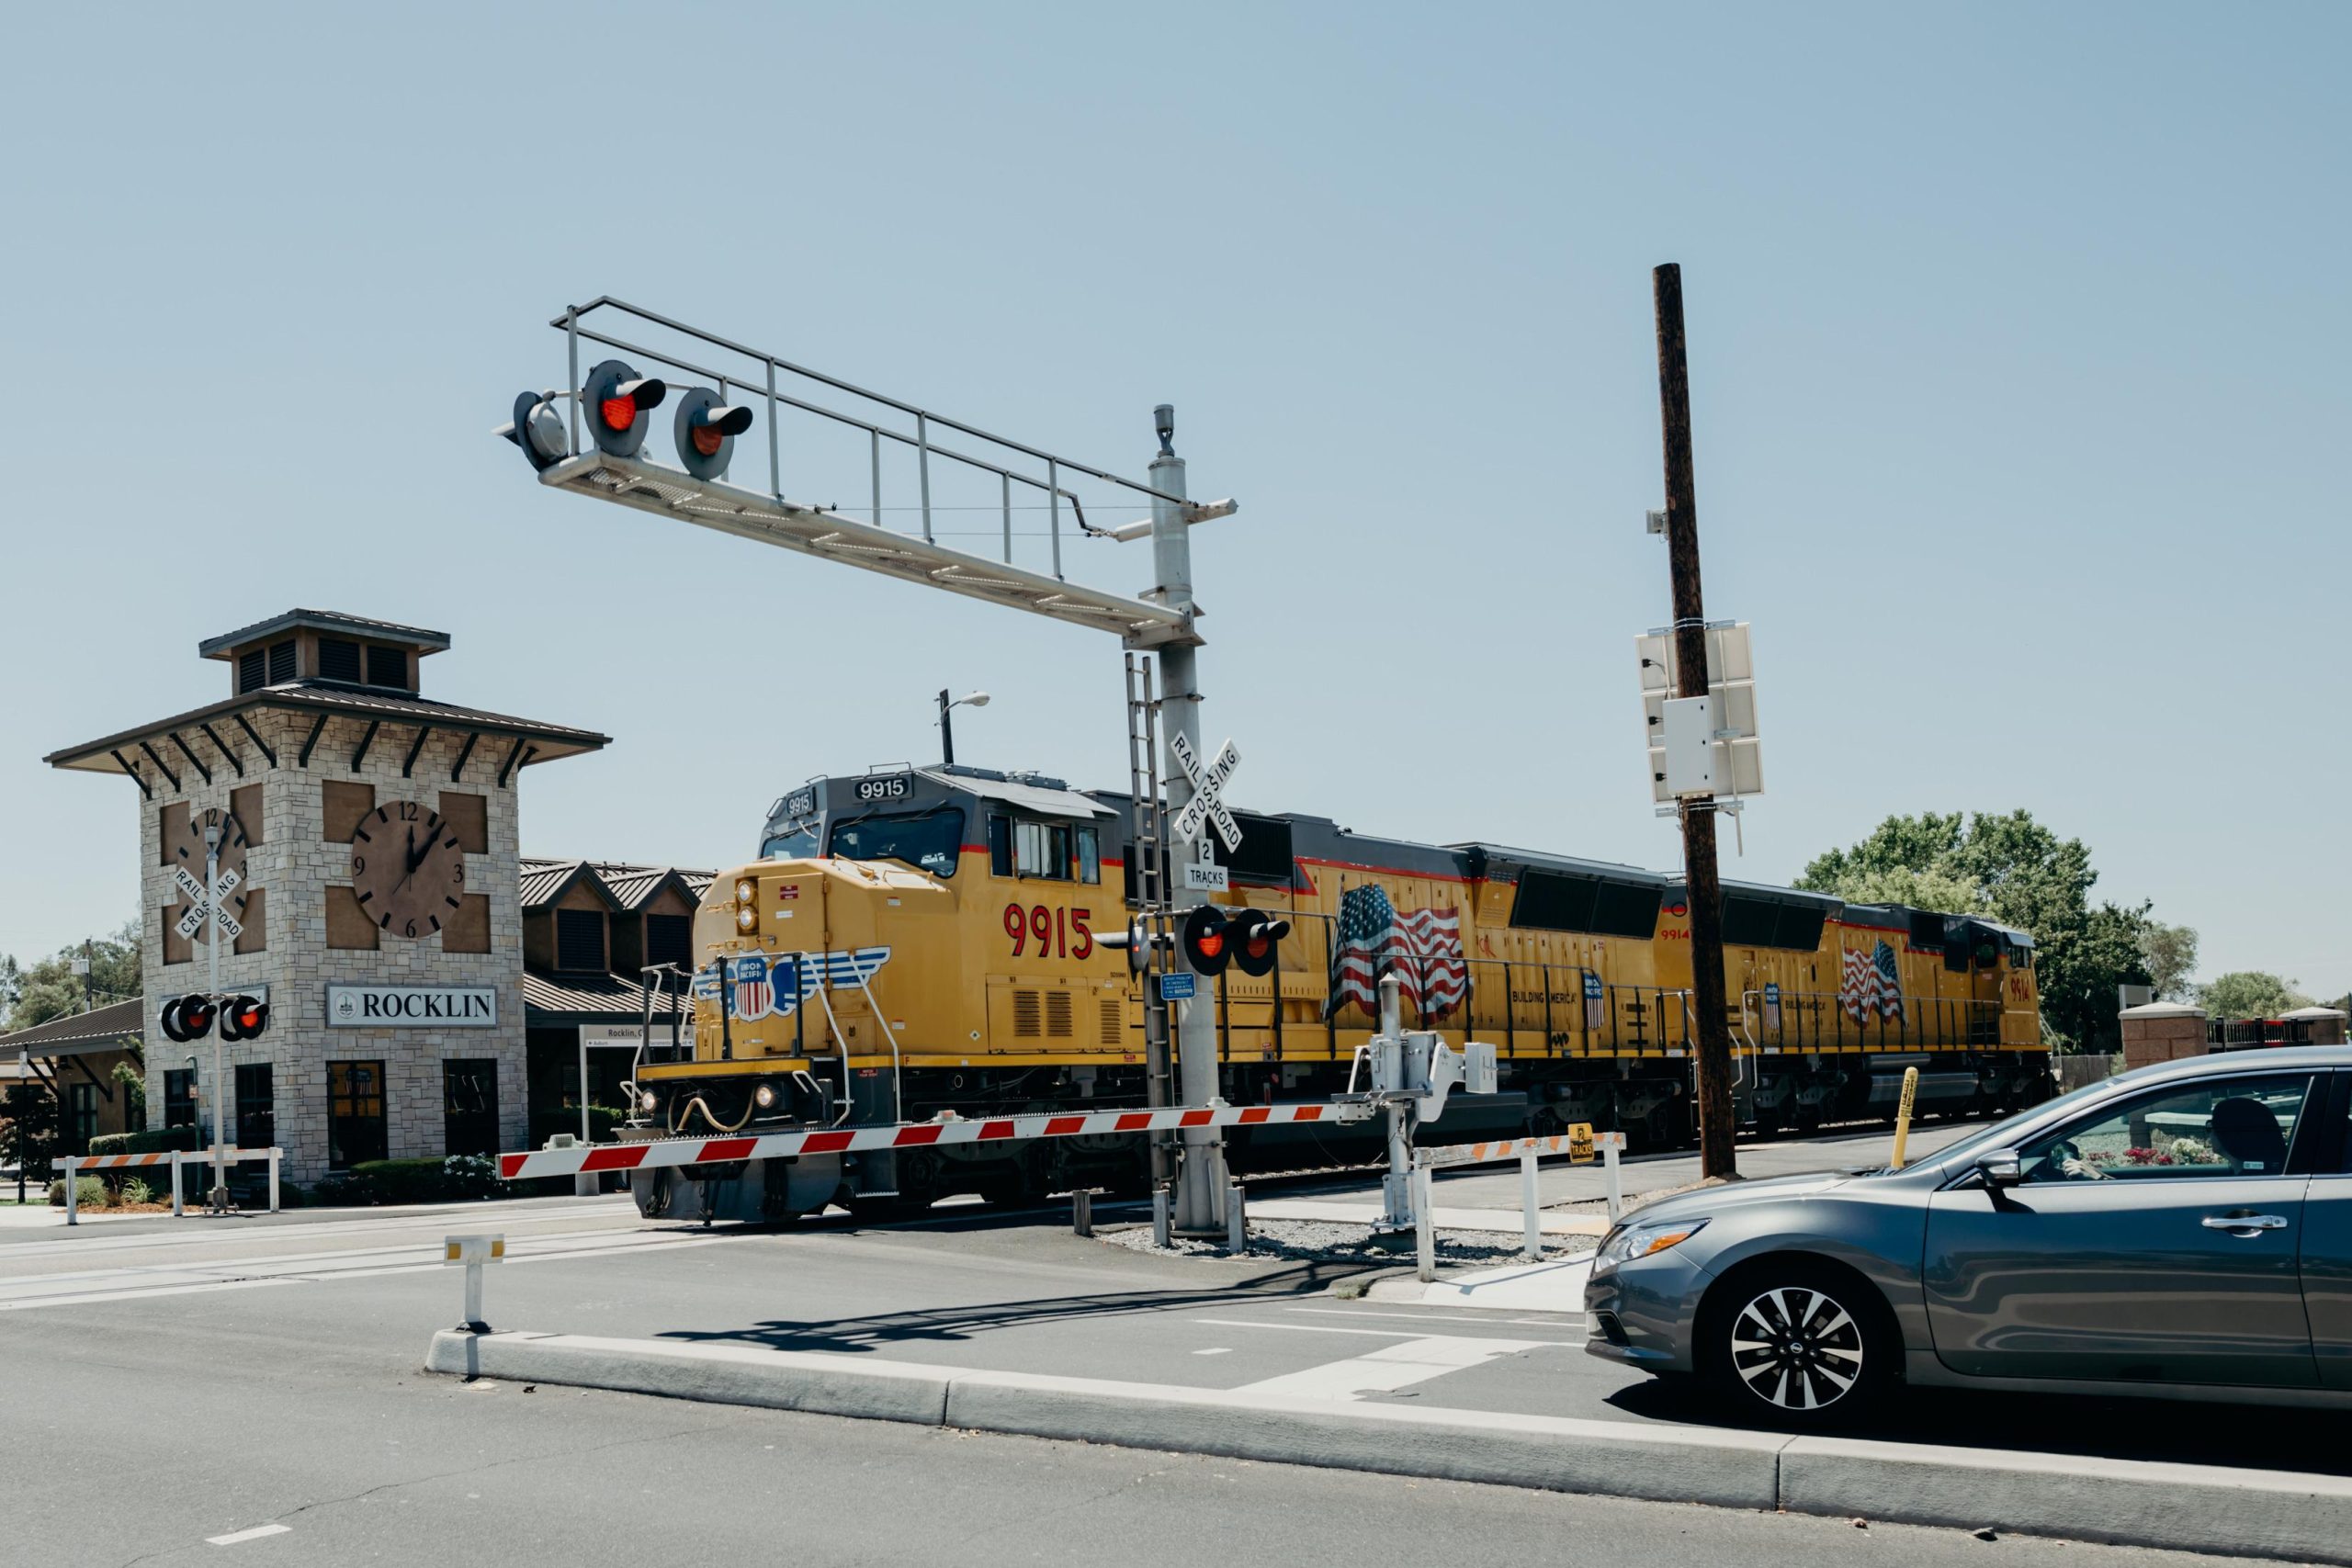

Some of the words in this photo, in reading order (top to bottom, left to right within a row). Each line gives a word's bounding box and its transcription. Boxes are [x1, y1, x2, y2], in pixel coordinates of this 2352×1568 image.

[860, 779, 904, 799] 9915
[1174, 736, 1200, 784] RAIL
[1211, 799, 1238, 845] ROAD
[1182, 750, 1236, 835] CROSSING
[398, 800, 419, 821] 12
[789, 794, 809, 815] 9915
[204, 807, 218, 828] 12
[1202, 842, 1210, 861] 2
[239, 860, 248, 881] 3
[354, 856, 366, 876] 9
[452, 863, 464, 884] 3
[175, 871, 202, 900] RAIL
[1190, 869, 1224, 886] TRACKS
[180, 874, 236, 933] CROSING
[405, 919, 416, 939] 6
[1003, 903, 1093, 960] 9915
[1661, 930, 1690, 940] 9914
[1512, 991, 1544, 1004] BUILDING
[2010, 977, 2030, 1002] 9914
[362, 993, 491, 1018] ROCKLIN
[608, 1029, 638, 1037] Rocklin,
[1578, 1130, 1584, 1143] 2
[1571, 1144, 1593, 1156] TRACKS
